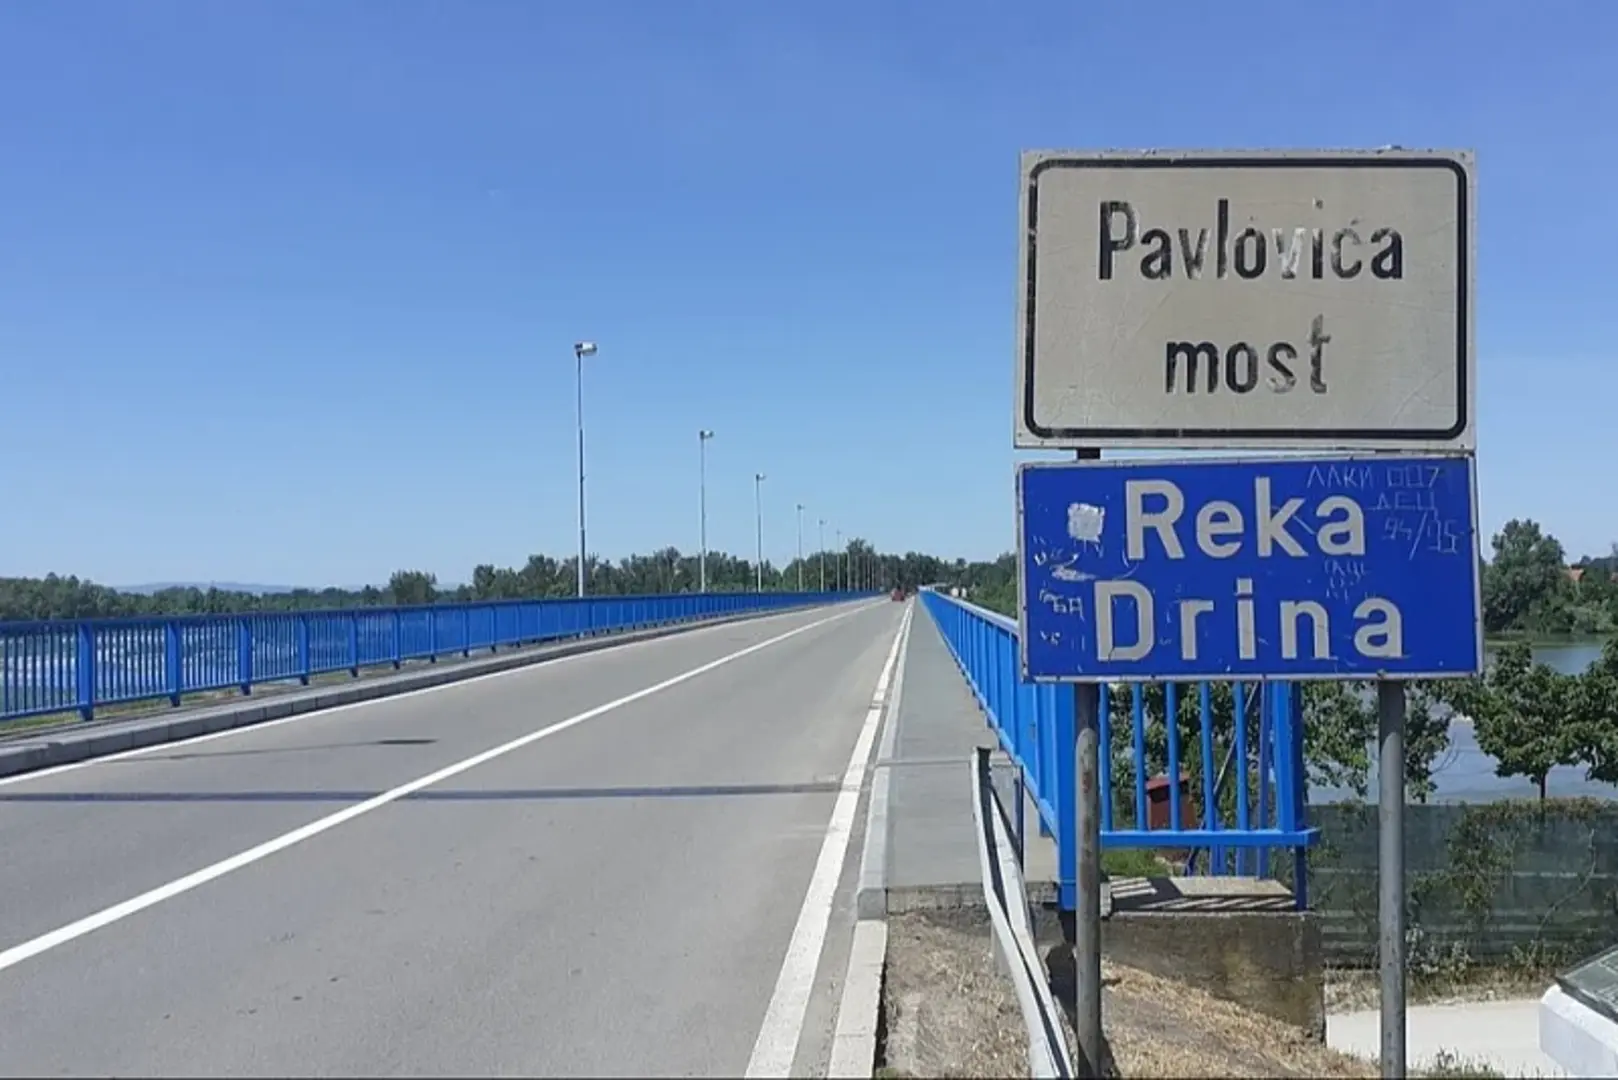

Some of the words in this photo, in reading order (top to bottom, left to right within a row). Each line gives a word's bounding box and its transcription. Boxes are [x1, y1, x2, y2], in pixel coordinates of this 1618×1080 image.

[1097, 198, 1403, 281] Pavlovića
[1165, 313, 1331, 394] most
[1125, 477, 1366, 560] Reka
[1094, 578, 1403, 662] Drina
